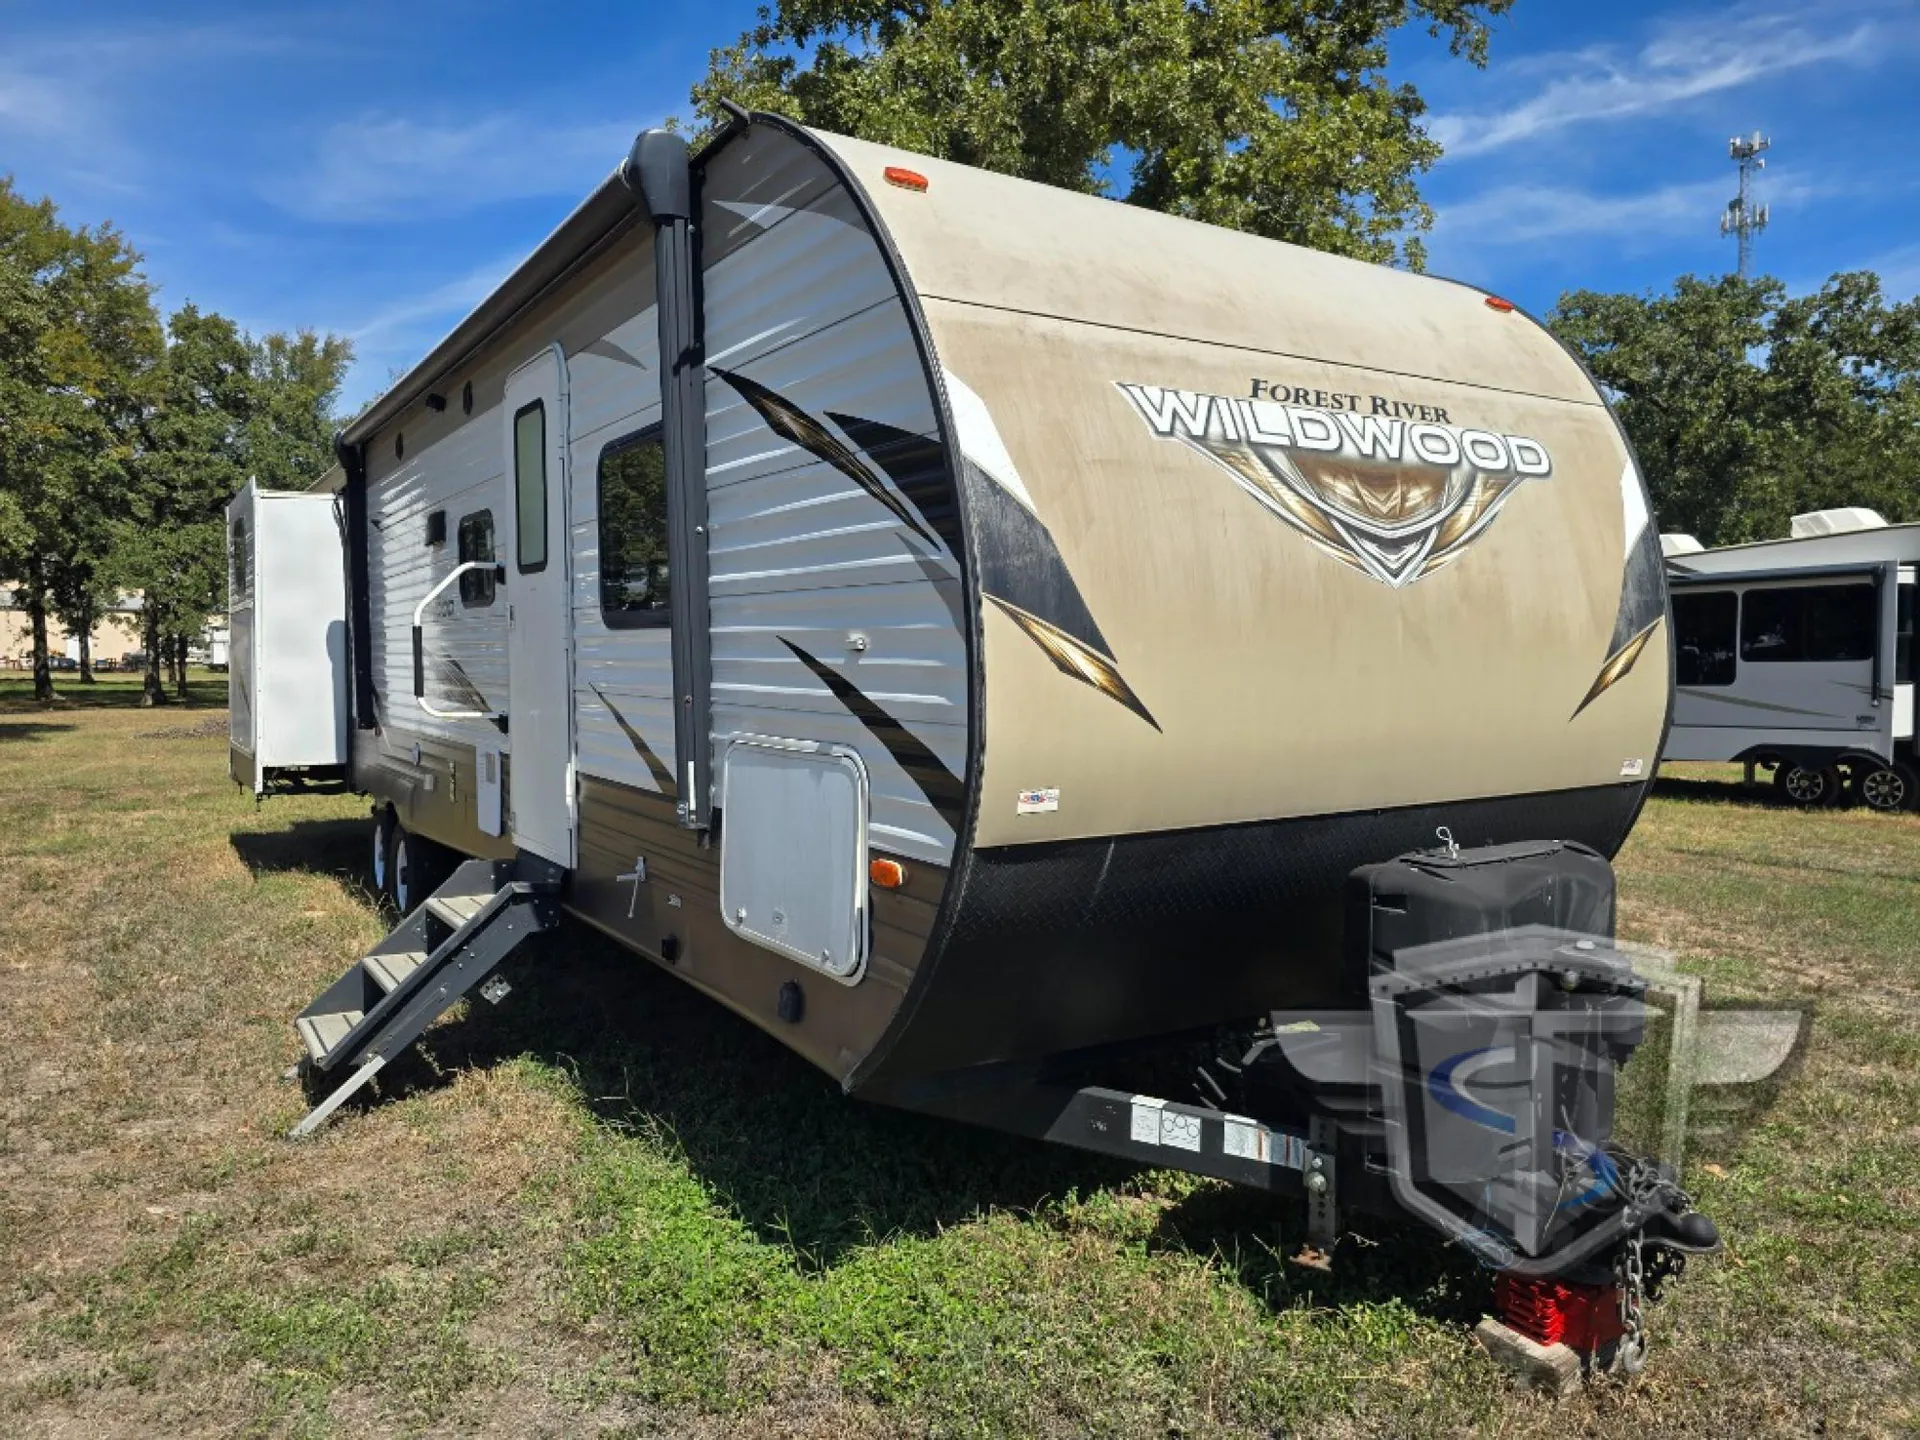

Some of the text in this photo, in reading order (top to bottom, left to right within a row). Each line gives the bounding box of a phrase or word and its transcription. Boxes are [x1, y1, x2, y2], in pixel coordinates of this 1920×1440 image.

[1116, 382, 1552, 475] WILDWOOD
[1250, 378, 1452, 424] FOREST RIVER
